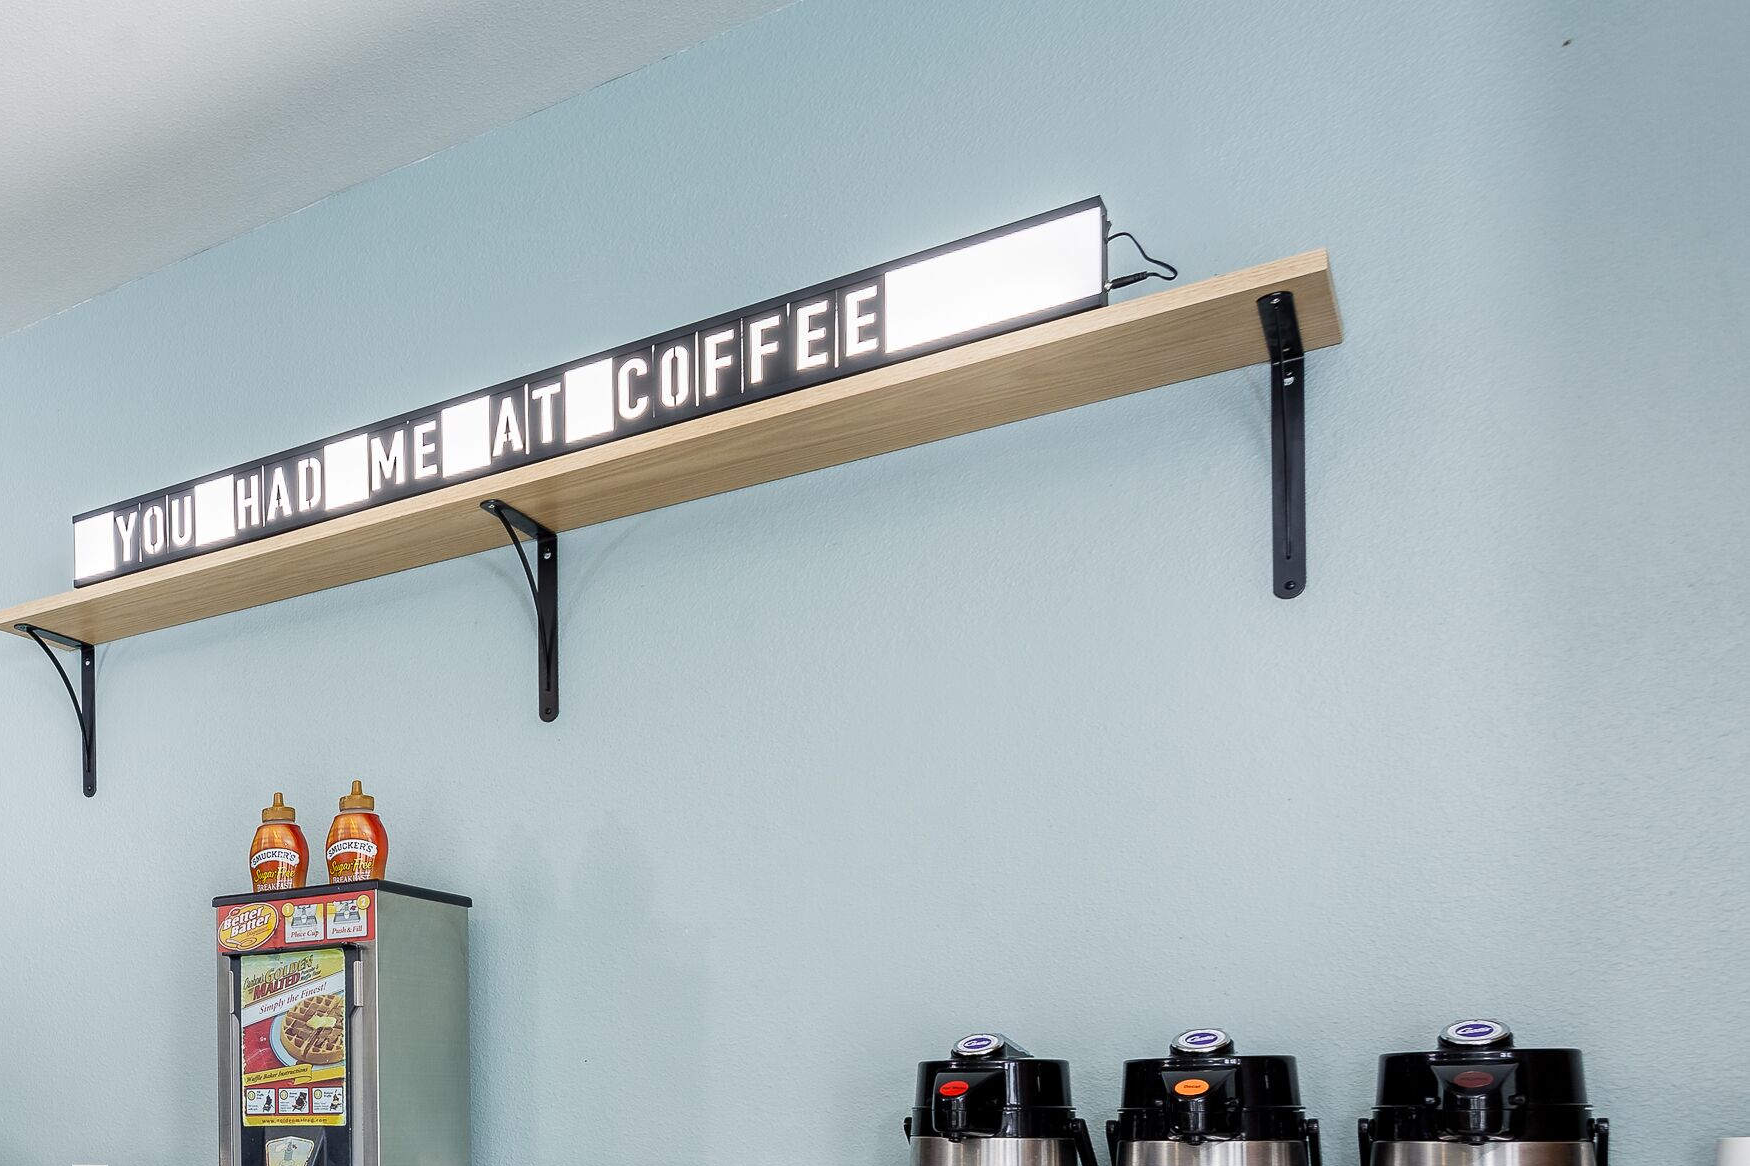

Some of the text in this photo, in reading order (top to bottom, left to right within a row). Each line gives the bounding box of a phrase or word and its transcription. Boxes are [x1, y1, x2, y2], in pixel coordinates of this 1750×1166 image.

[114, 284, 879, 562] YOU HAD ME AT COFFEE
[252, 850, 296, 866] SMUCKER'S
[328, 841, 374, 858] SMUCKER'S
[222, 906, 264, 930] Better
[230, 913, 272, 938] Batter
[332, 926, 346, 934] Push
[352, 924, 363, 933] Fill
[307, 930, 320, 938] Cup
[264, 954, 314, 983] GOLDEN
[253, 972, 301, 1000] MALTED
[259, 981, 327, 1014] Simply the Finest!
[263, 1072, 278, 1080] Baker
[277, 1067, 308, 1078] Instructions
